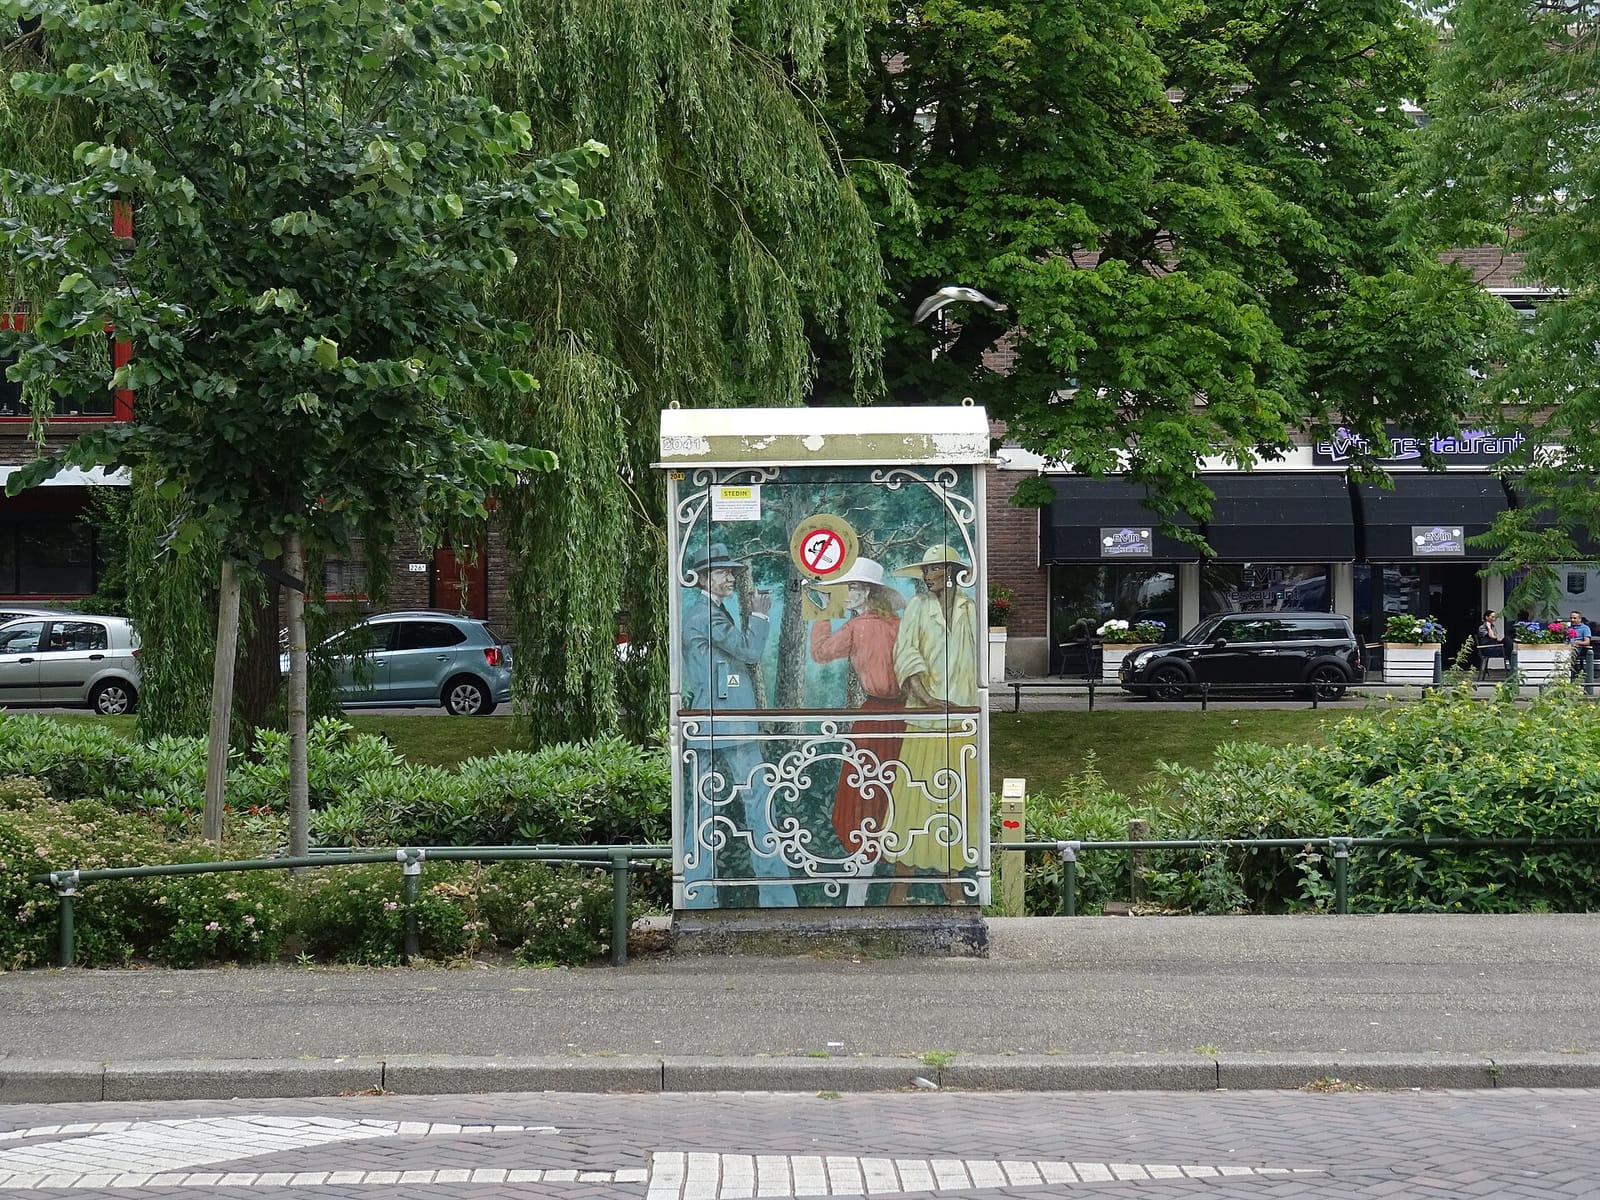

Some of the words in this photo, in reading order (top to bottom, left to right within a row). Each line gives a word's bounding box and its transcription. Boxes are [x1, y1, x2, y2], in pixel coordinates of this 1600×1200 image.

[663, 440, 701, 450] 2041
[1391, 431, 1526, 455] retaurant
[1113, 533, 1140, 544] evin
[1424, 531, 1452, 542] evin
[1241, 566, 1285, 583] evin
[1226, 589, 1298, 601] restaurant
